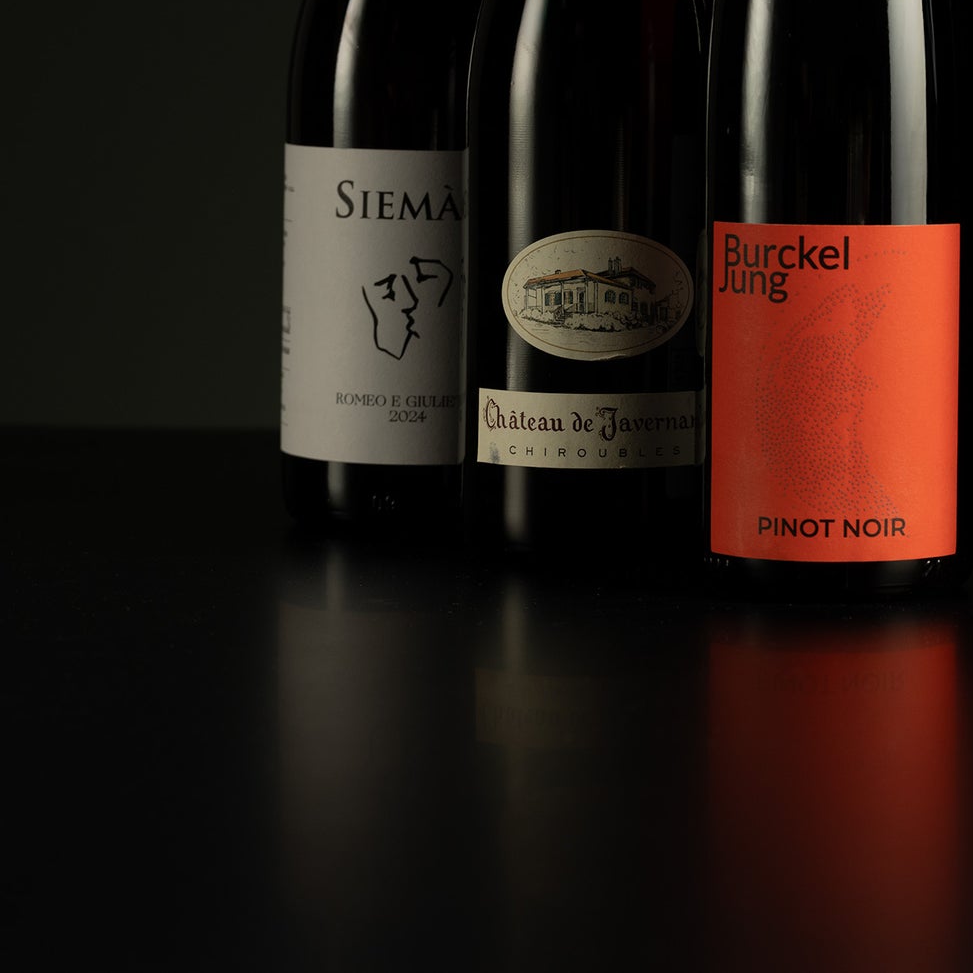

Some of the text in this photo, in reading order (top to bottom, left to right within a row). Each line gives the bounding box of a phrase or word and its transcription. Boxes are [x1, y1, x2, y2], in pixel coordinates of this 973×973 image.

[335, 179, 462, 221] SIEMÀ
[724, 233, 850, 270] Burckel
[718, 267, 789, 304] Jung
[336, 392, 456, 408] ROMEO E GIULIE
[388, 410, 427, 423] 2024
[483, 396, 697, 442] Château de Javerna
[509, 445, 681, 459] CHIROUBLES
[757, 516, 907, 538] PINOT NOIR
